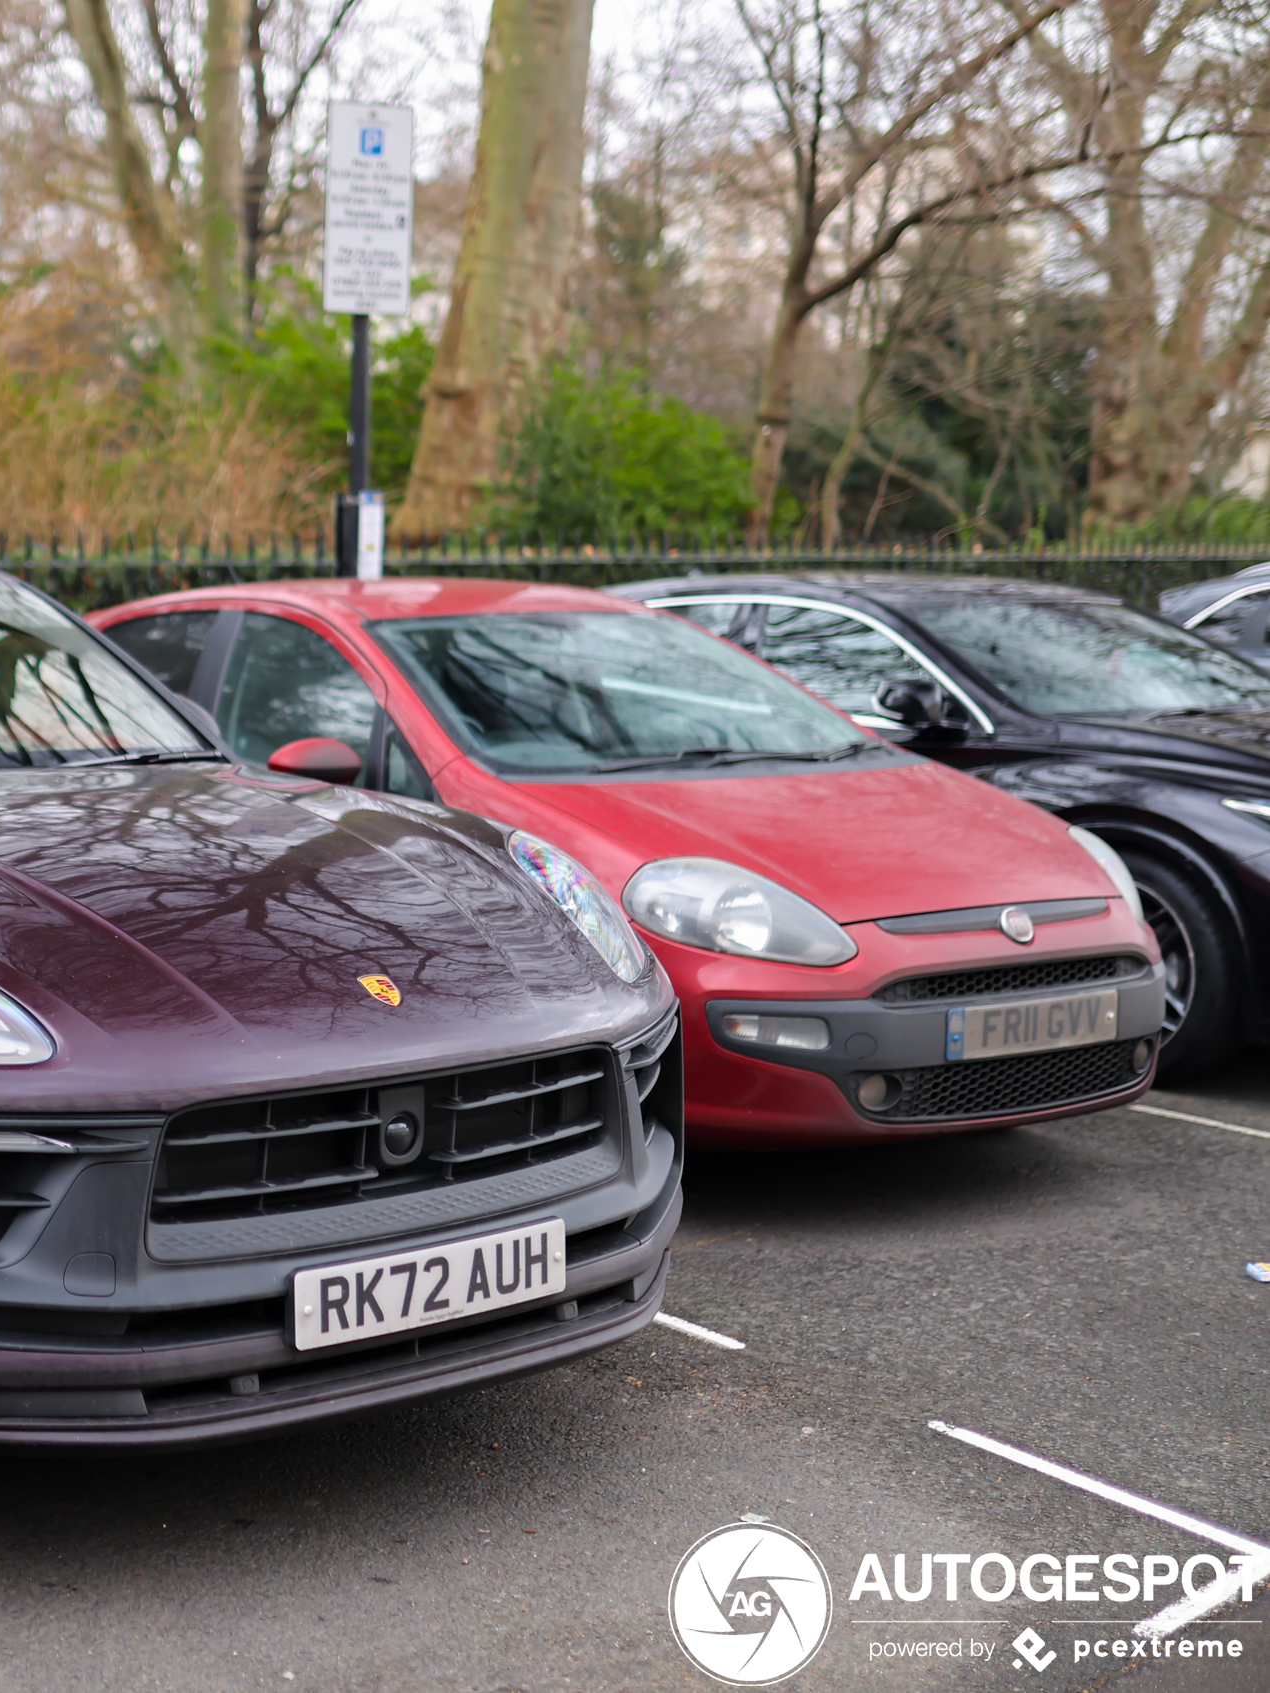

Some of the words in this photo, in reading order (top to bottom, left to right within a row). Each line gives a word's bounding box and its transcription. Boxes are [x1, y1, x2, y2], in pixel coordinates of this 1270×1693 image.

[982, 1006, 1039, 1048] FR11
[1047, 996, 1101, 1039] GVV
[320, 1256, 450, 1334] RK72
[466, 1232, 548, 1304] AUH
